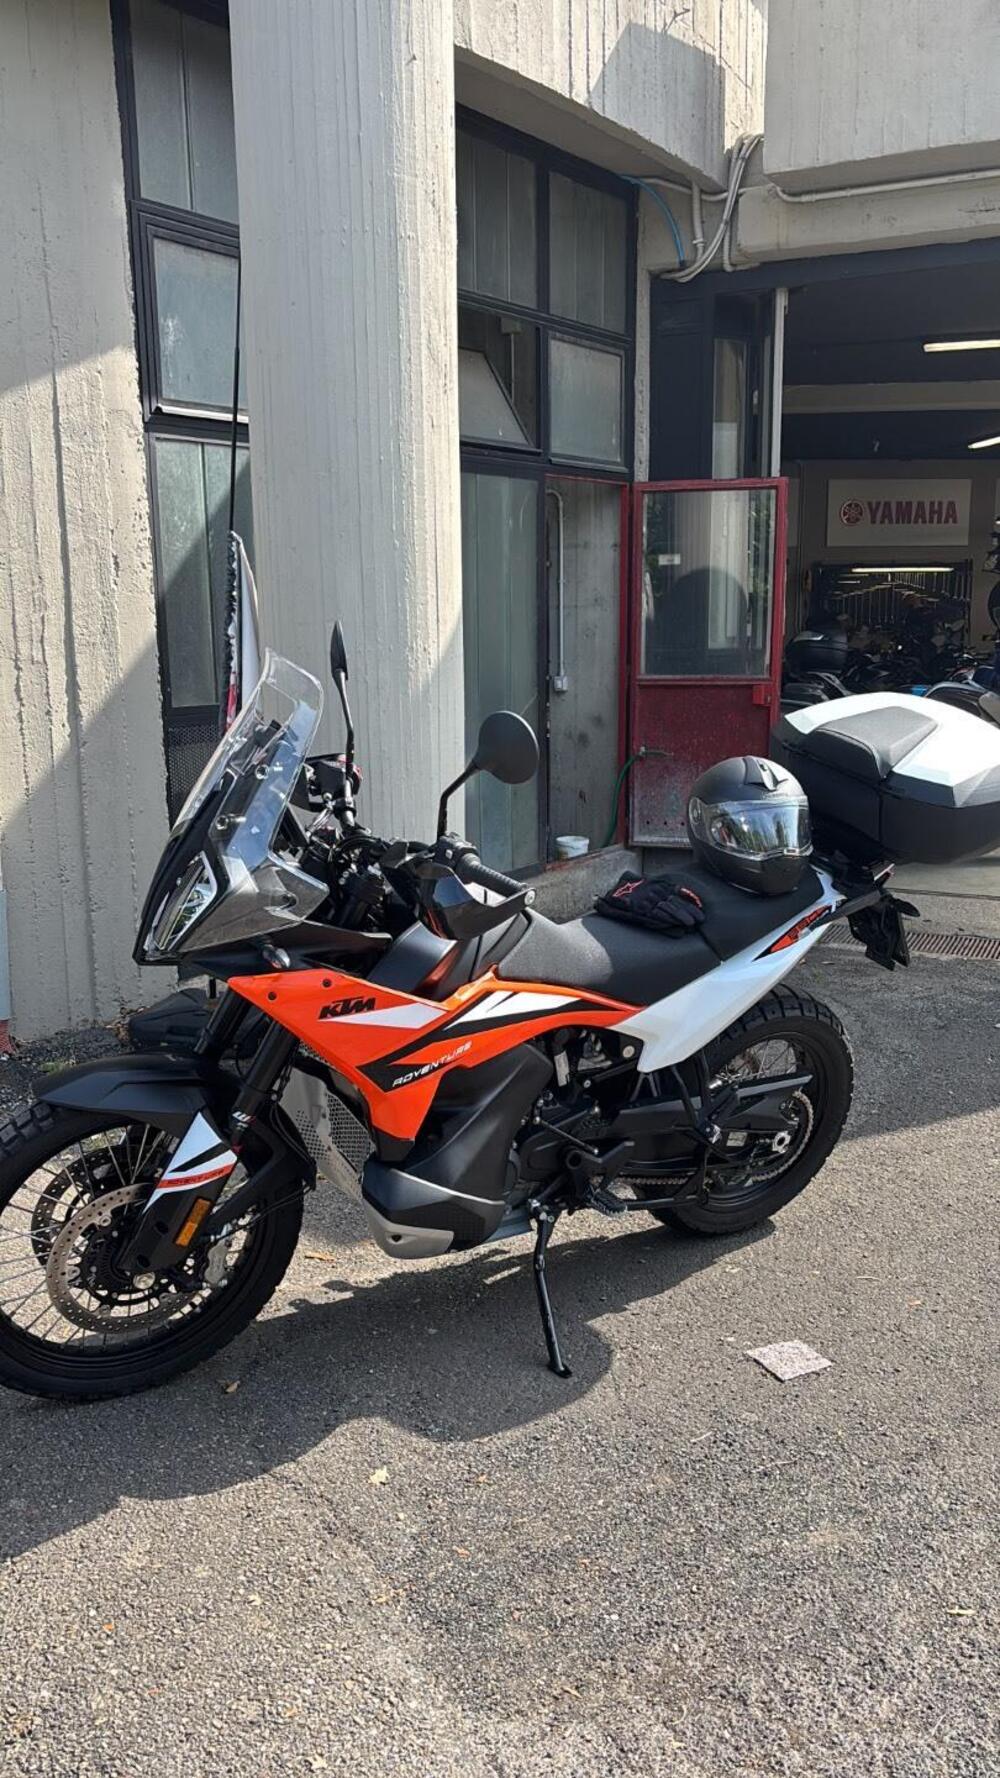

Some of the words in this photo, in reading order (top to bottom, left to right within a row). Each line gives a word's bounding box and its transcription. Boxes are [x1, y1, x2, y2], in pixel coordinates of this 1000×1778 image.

[867, 500, 958, 524] YAMAHA
[319, 995, 376, 1020] KTM
[392, 1041, 473, 1087] ADVENTURE
